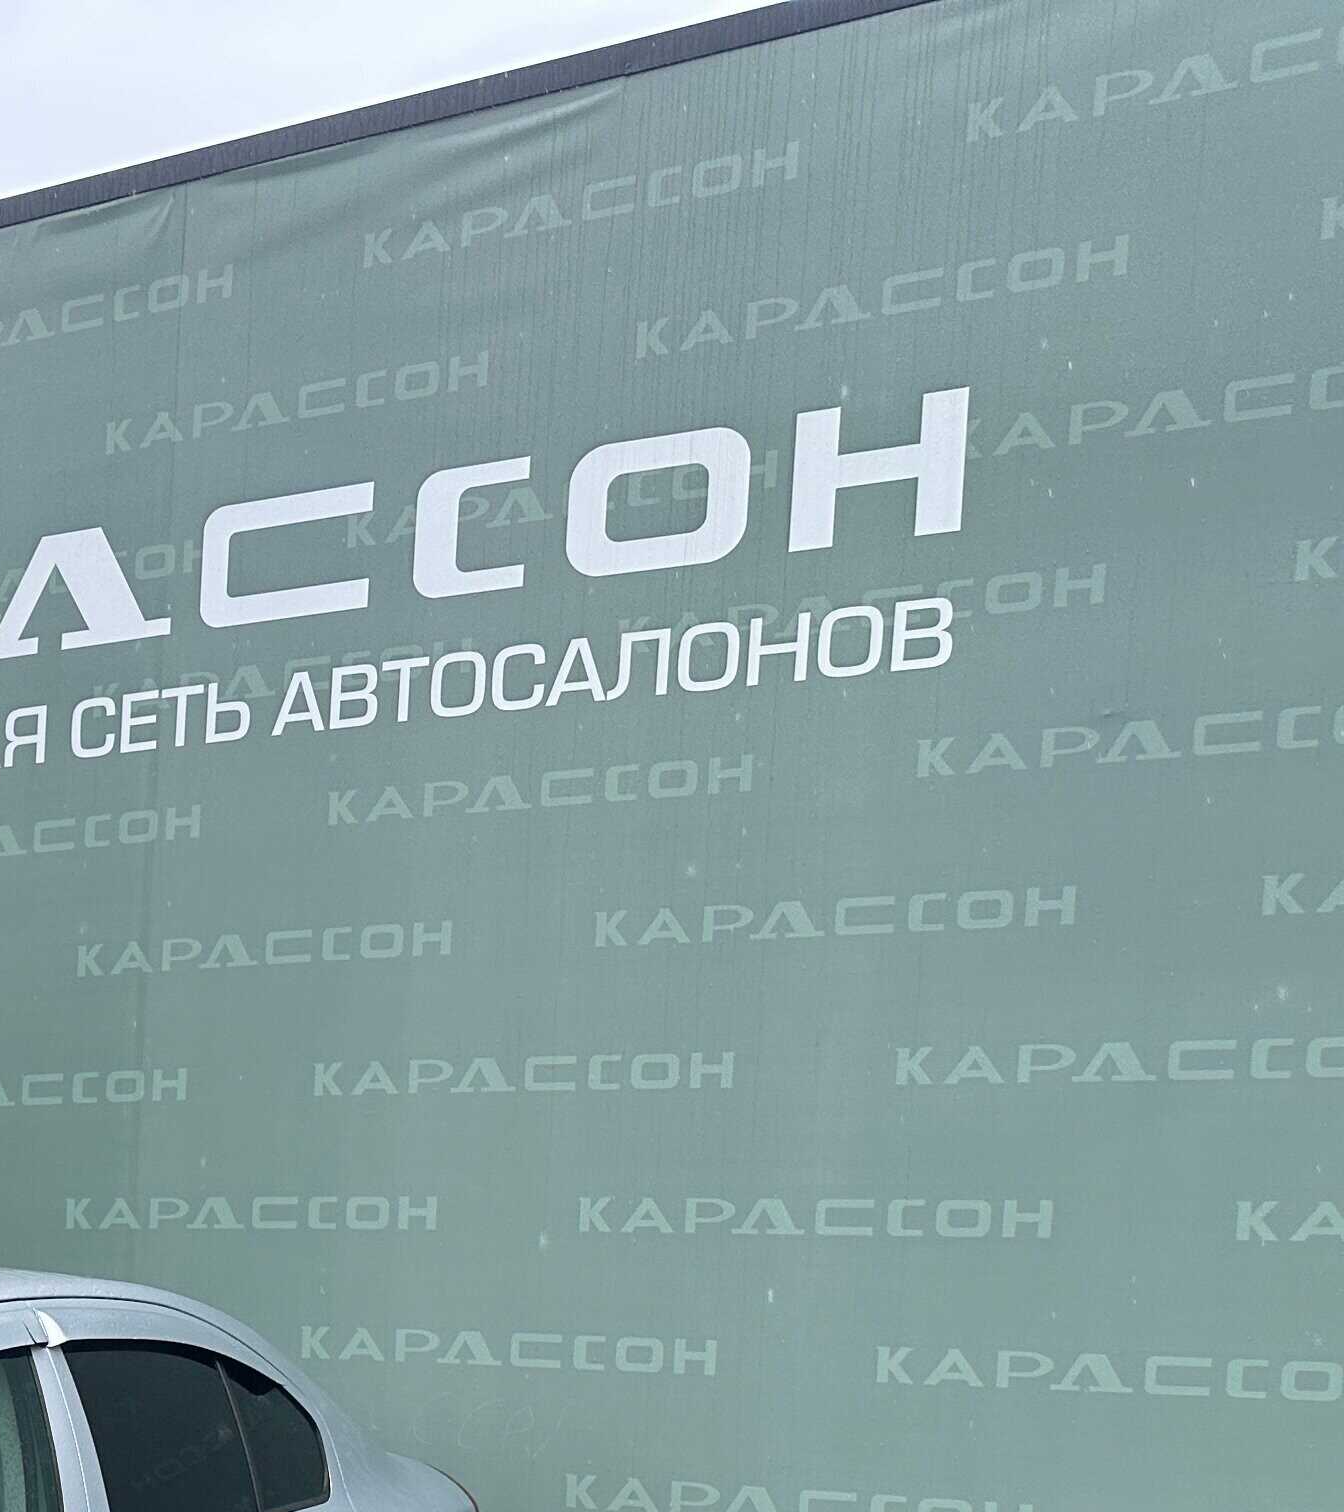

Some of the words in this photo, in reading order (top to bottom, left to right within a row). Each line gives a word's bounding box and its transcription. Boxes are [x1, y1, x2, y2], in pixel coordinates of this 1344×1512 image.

[966, 27, 1344, 142] КАРАС
[362, 141, 800, 269] КАРАССОН
[636, 235, 1129, 359] КАРАССОН
[106, 351, 489, 455] КАРАССОН
[70, 682, 250, 759] СЕТЬ
[271, 597, 954, 737] АВТОСАЛОНОВ
[916, 704, 1344, 778] КАРАСС
[328, 753, 753, 825] КАРАССОН
[76, 920, 452, 977] КАРАССОН
[594, 886, 1077, 947] КАРАССОН
[313, 1051, 735, 1097] КАРАССОН
[65, 1196, 438, 1231] КАРАССОН
[578, 1196, 1053, 1239] КАРАССОН
[301, 1326, 717, 1376] КАРАССОН
